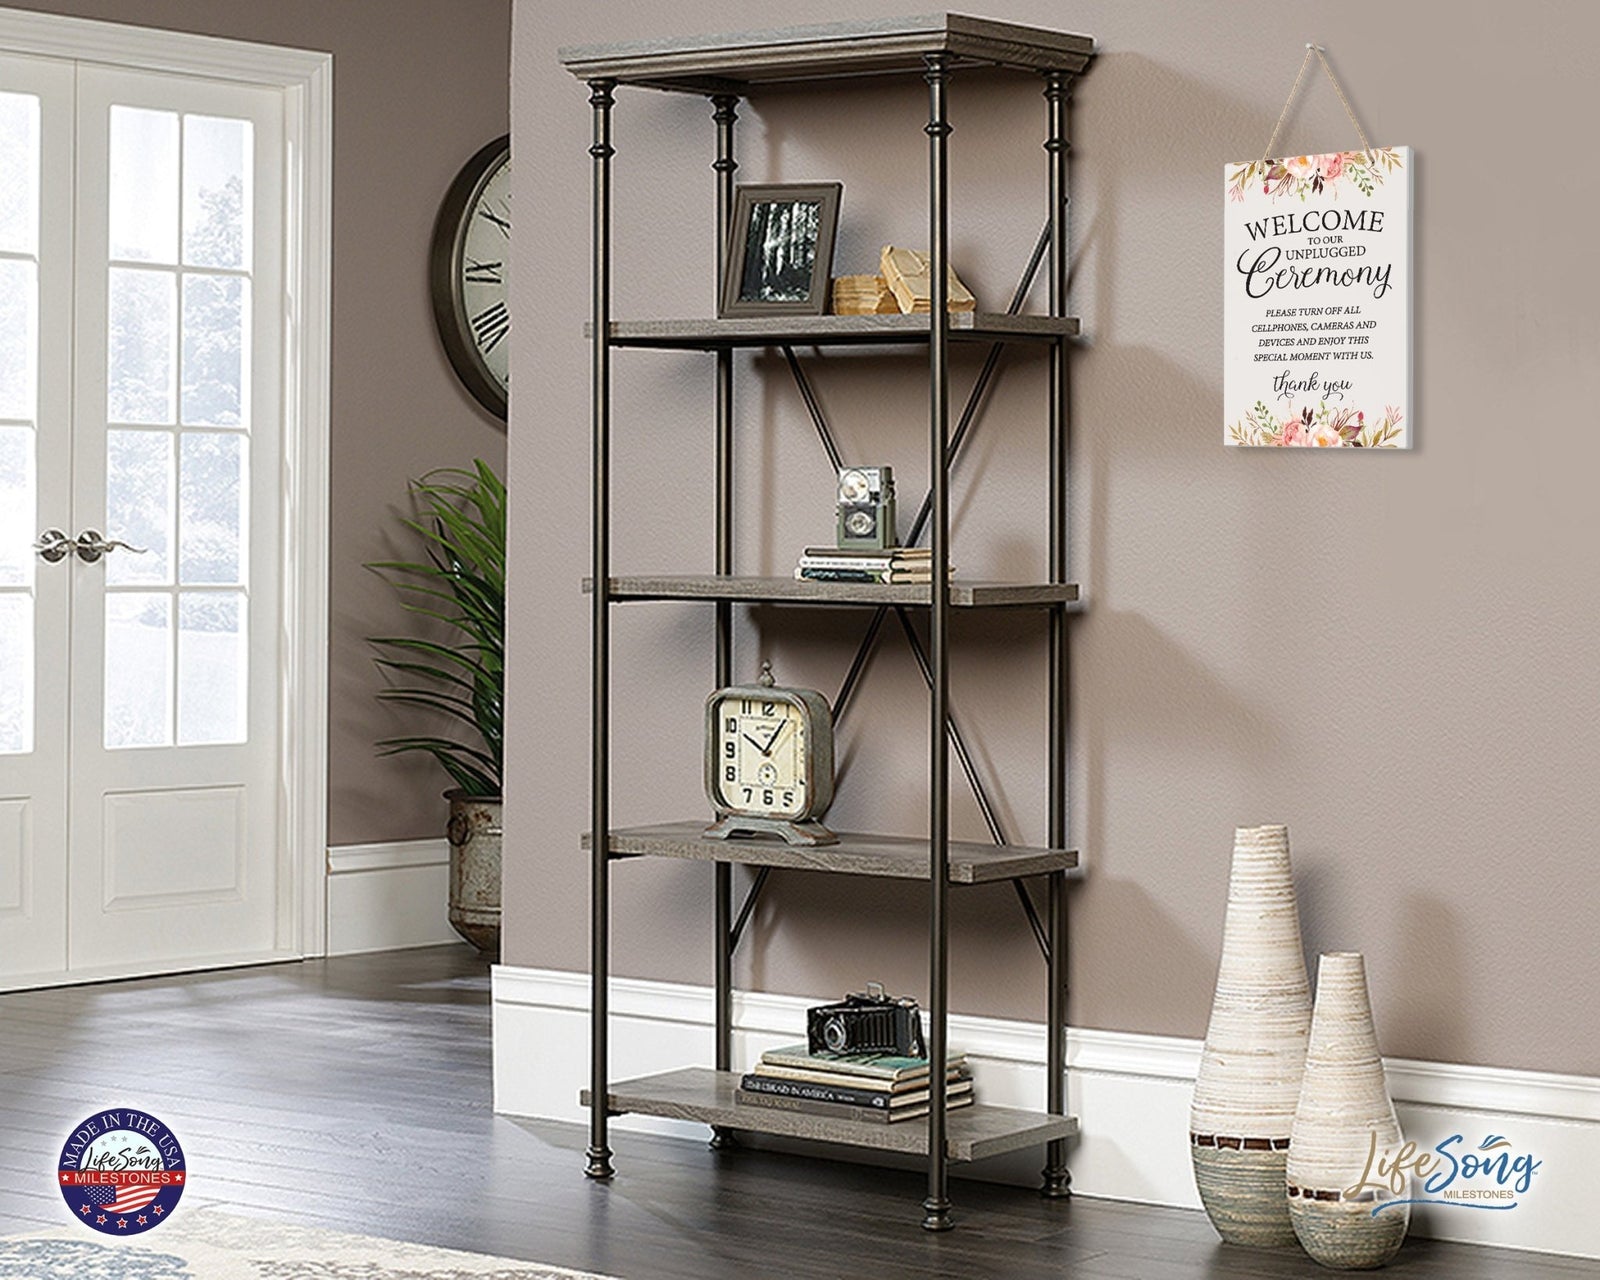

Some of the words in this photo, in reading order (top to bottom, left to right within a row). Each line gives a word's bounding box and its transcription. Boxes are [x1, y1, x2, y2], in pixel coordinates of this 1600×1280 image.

[1244, 209, 1385, 241] WELCOME
[1308, 237, 1321, 246] TO
[1323, 235, 1344, 244] OUR
[1286, 245, 1366, 260] UNPLUGGED
[1236, 246, 1393, 299] Ceremony
[1266, 308, 1297, 317] PLEASE
[1298, 307, 1324, 316] TURN
[1325, 306, 1343, 315] OFF
[1344, 305, 1361, 314] ALL
[1251, 322, 1309, 332] CELLPHONES,
[1310, 321, 1354, 331] CAMERAS
[1355, 320, 1377, 330] AND
[1258, 338, 1295, 347] DEVICES
[1296, 337, 1317, 346] AND
[1318, 336, 1347, 346] ENJOY
[1348, 335, 1370, 344] THIS
[1253, 353, 1289, 362] SPECIAL
[1289, 352, 1331, 361] MOMENT
[1333, 351, 1359, 360] WITH
[1360, 351, 1374, 360] US.
[1272, 369, 1321, 401] thank
[1322, 380, 1353, 401] you
[762, 701, 775, 717] 12
[725, 717, 737, 733] 10
[725, 742, 736, 759] 9
[725, 766, 736, 781] 8
[743, 788, 753, 803] 7
[763, 790, 773, 805] 6
[783, 792, 794, 807] 5
